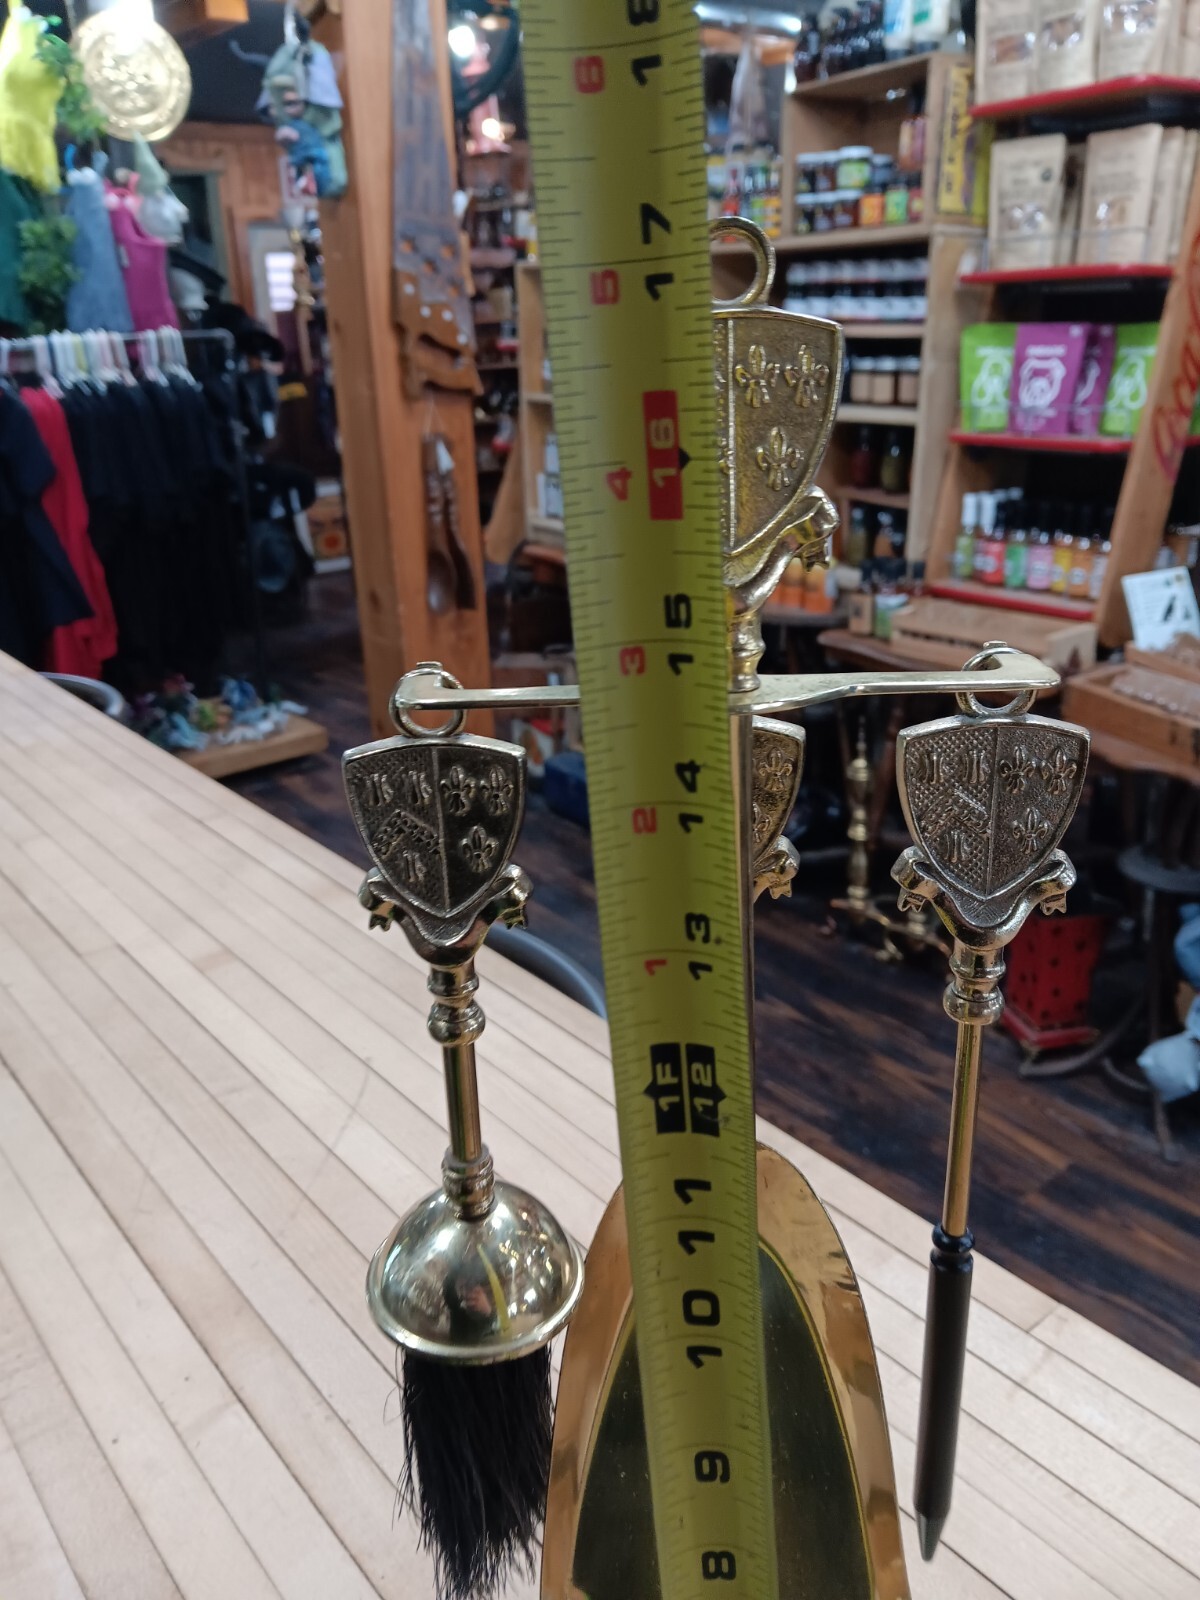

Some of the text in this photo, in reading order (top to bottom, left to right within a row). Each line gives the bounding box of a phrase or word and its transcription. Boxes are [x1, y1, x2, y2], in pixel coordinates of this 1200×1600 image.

[638, 202, 675, 302] 17
[589, 268, 620, 306] 5
[650, 417, 678, 488] 16
[606, 466, 632, 502] 4
[663, 592, 693, 677] 15
[620, 645, 647, 676] 3
[632, 807, 657, 835] 2
[675, 758, 705, 834] 14
[644, 957, 668, 977] 1
[684, 911, 713, 981] 13
[655, 1061, 680, 1112] 1F
[691, 1062, 714, 1113] 12
[674, 1178, 716, 1256] 11
[682, 1288, 723, 1369] 10
[694, 1449, 731, 1484] 9
[701, 1550, 737, 1581] 8
